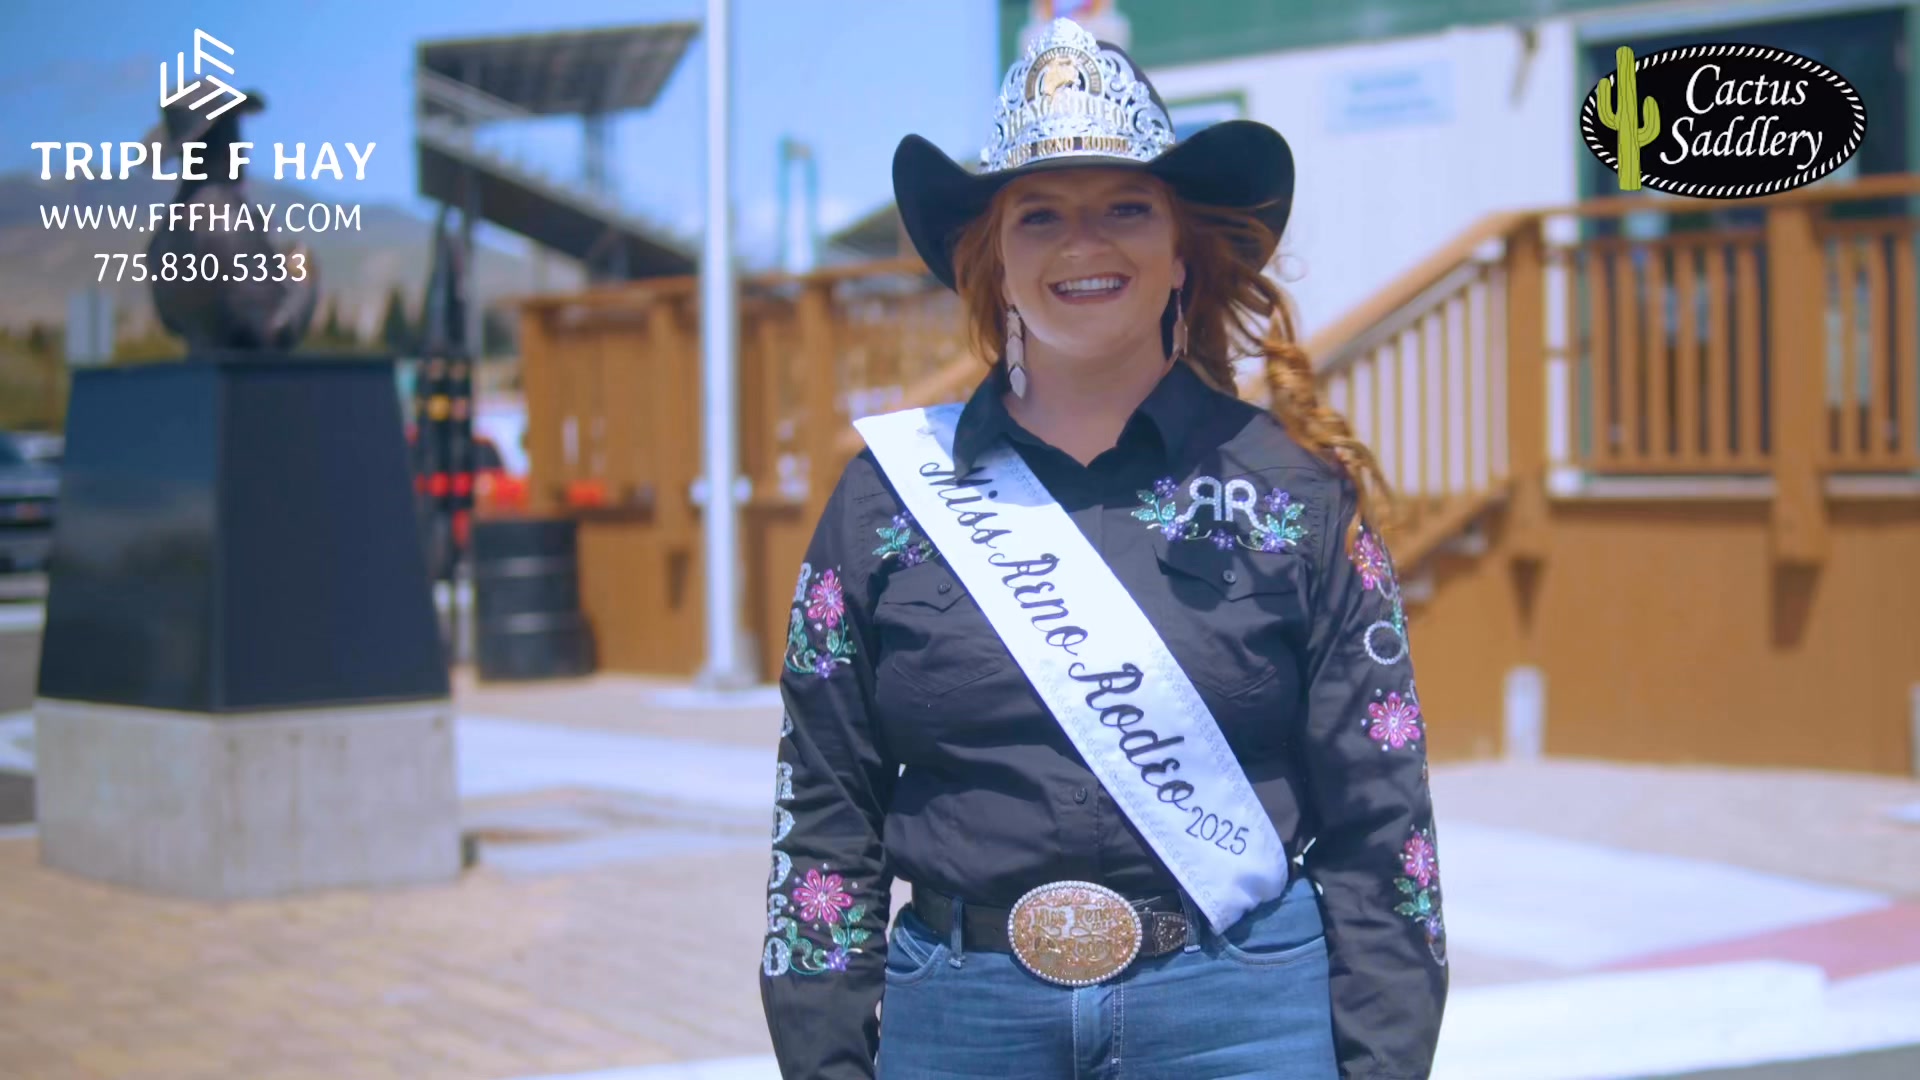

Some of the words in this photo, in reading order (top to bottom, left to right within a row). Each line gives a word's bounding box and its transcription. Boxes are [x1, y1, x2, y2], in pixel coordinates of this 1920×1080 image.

[919, 462, 1012, 549] Miss
[988, 553, 1087, 656] Reno
[1068, 662, 1194, 811] Rodeo
[1185, 806, 1249, 855] 2025
